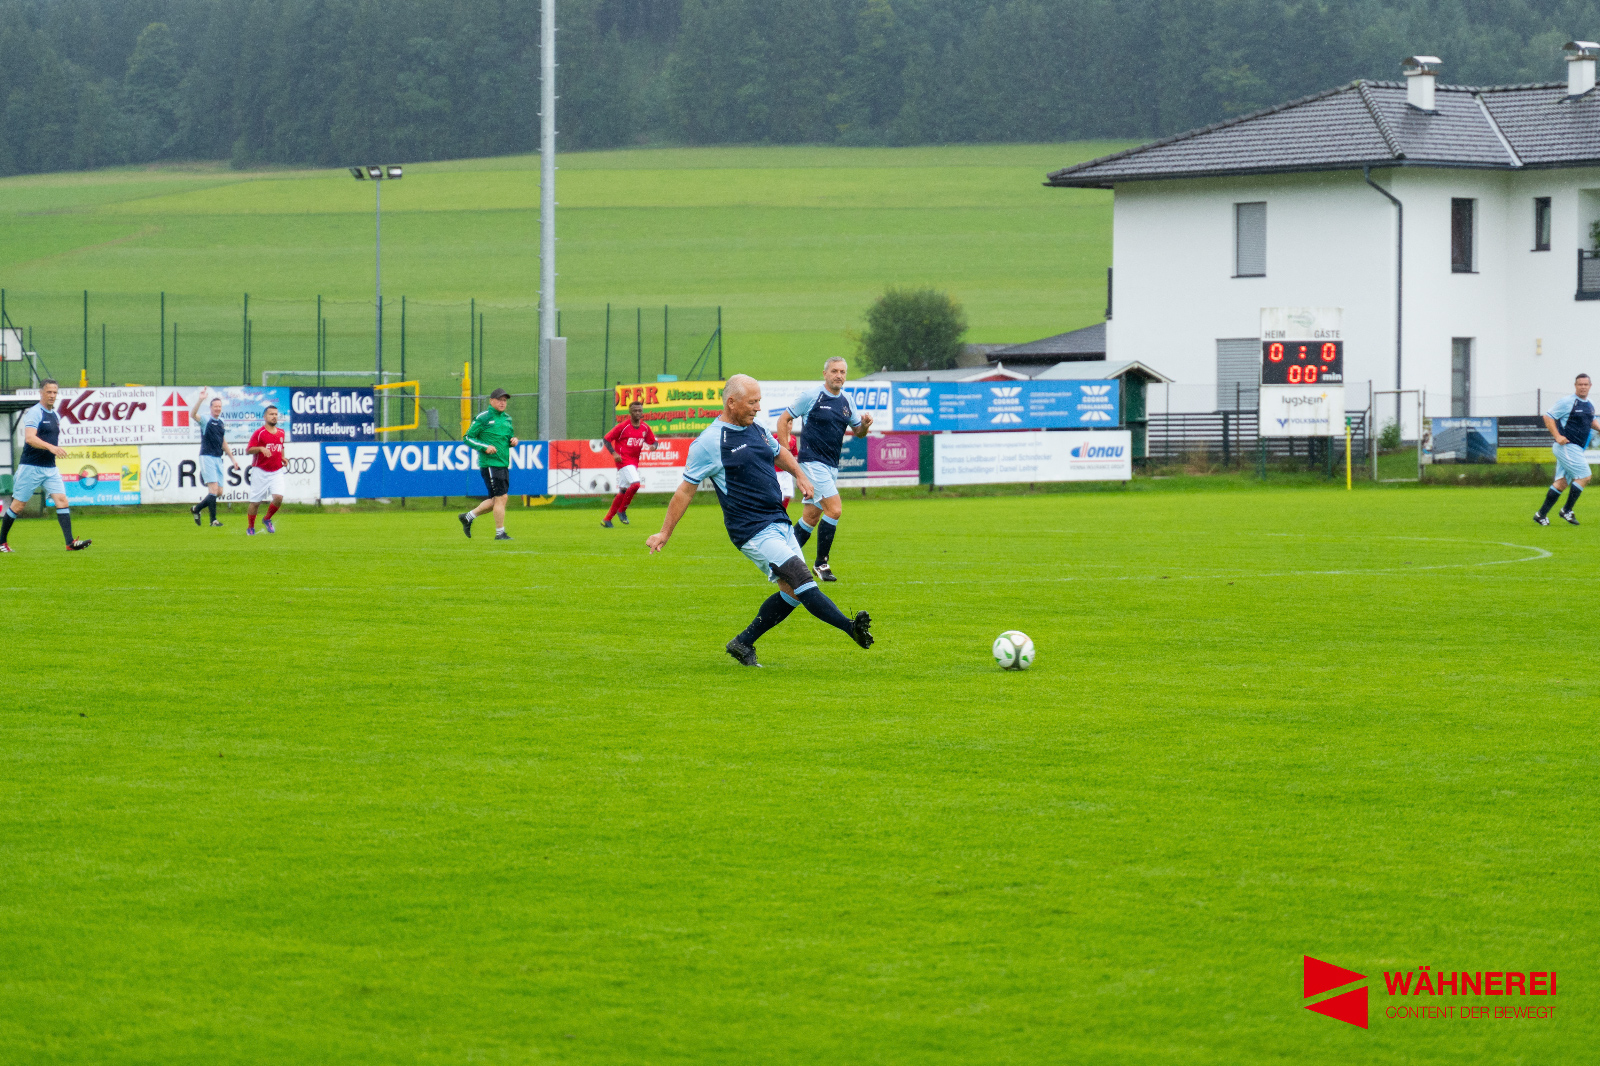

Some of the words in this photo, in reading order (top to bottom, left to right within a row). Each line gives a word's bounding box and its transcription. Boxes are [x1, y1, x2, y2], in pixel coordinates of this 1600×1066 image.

[1265, 330, 1286, 338] HEIM
[1314, 328, 1341, 338] GÄSTE
[1269, 342, 1284, 363] 0
[1321, 342, 1337, 362] 0
[1322, 372, 1342, 381] min
[99, 389, 155, 399] Straßwalchen
[57, 390, 147, 424] Kaser
[292, 391, 373, 414] Getränke
[292, 423, 311, 435] 5211
[314, 422, 355, 437] Friedburg
[92, 451, 129, 459] Badkomfort
[382, 444, 544, 471] VOLKSNK
[1070, 442, 1124, 458] donau
